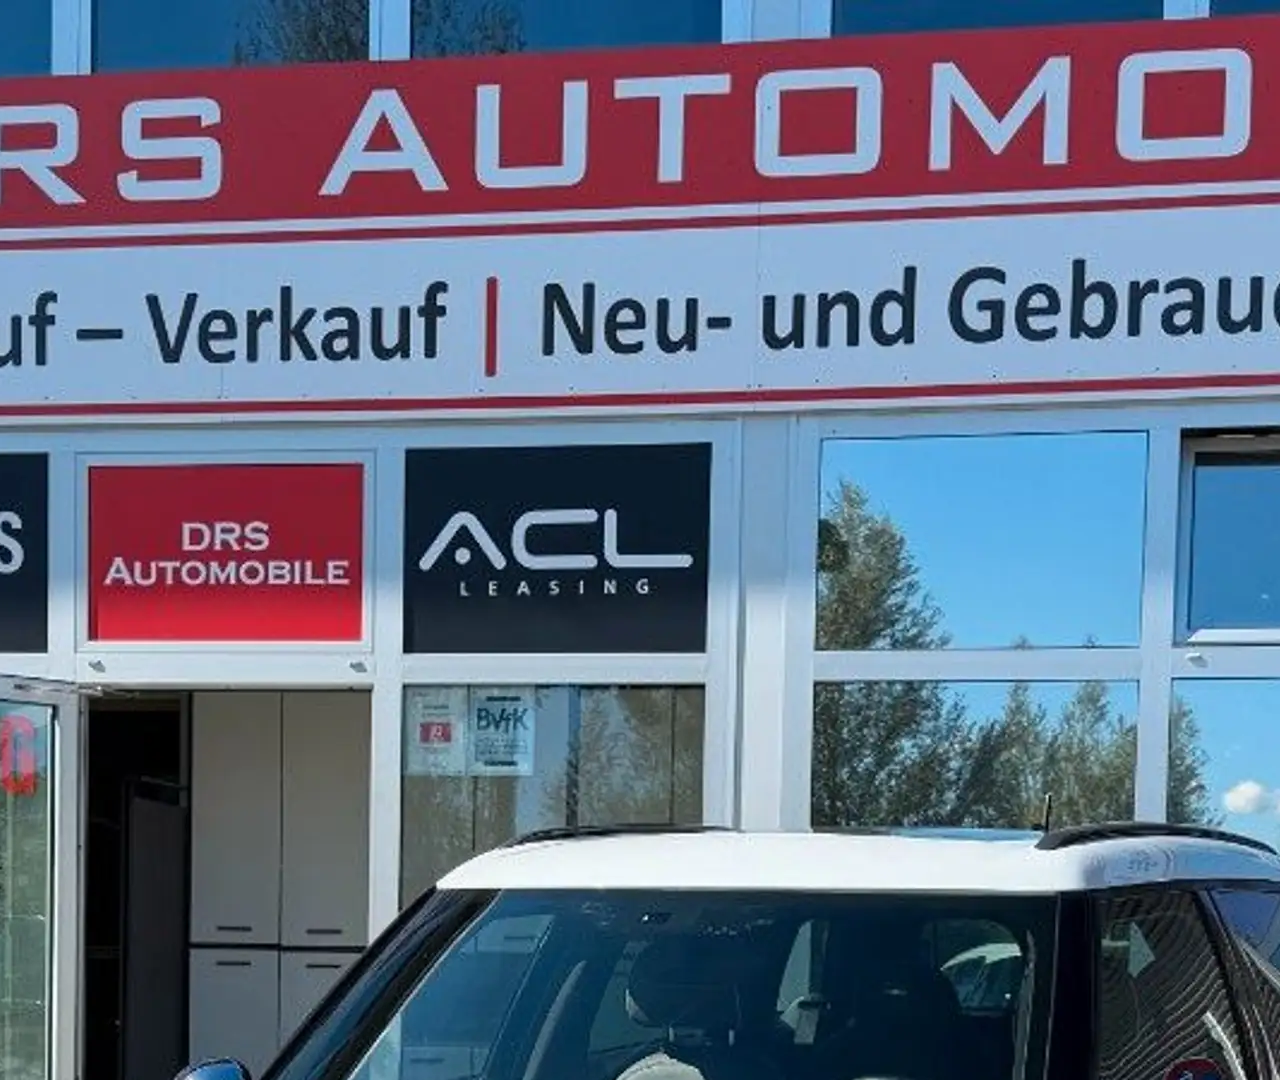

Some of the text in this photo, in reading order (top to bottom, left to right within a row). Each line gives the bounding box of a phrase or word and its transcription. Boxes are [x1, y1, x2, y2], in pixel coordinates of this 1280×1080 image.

[145, 280, 450, 365] Verkauf
[541, 282, 733, 357] Neu-
[760, 266, 917, 350] und
[182, 522, 270, 552] DRS
[419, 508, 693, 571] ACL
[104, 555, 350, 588] AUTOMOBILE
[459, 578, 651, 598] LEASING
